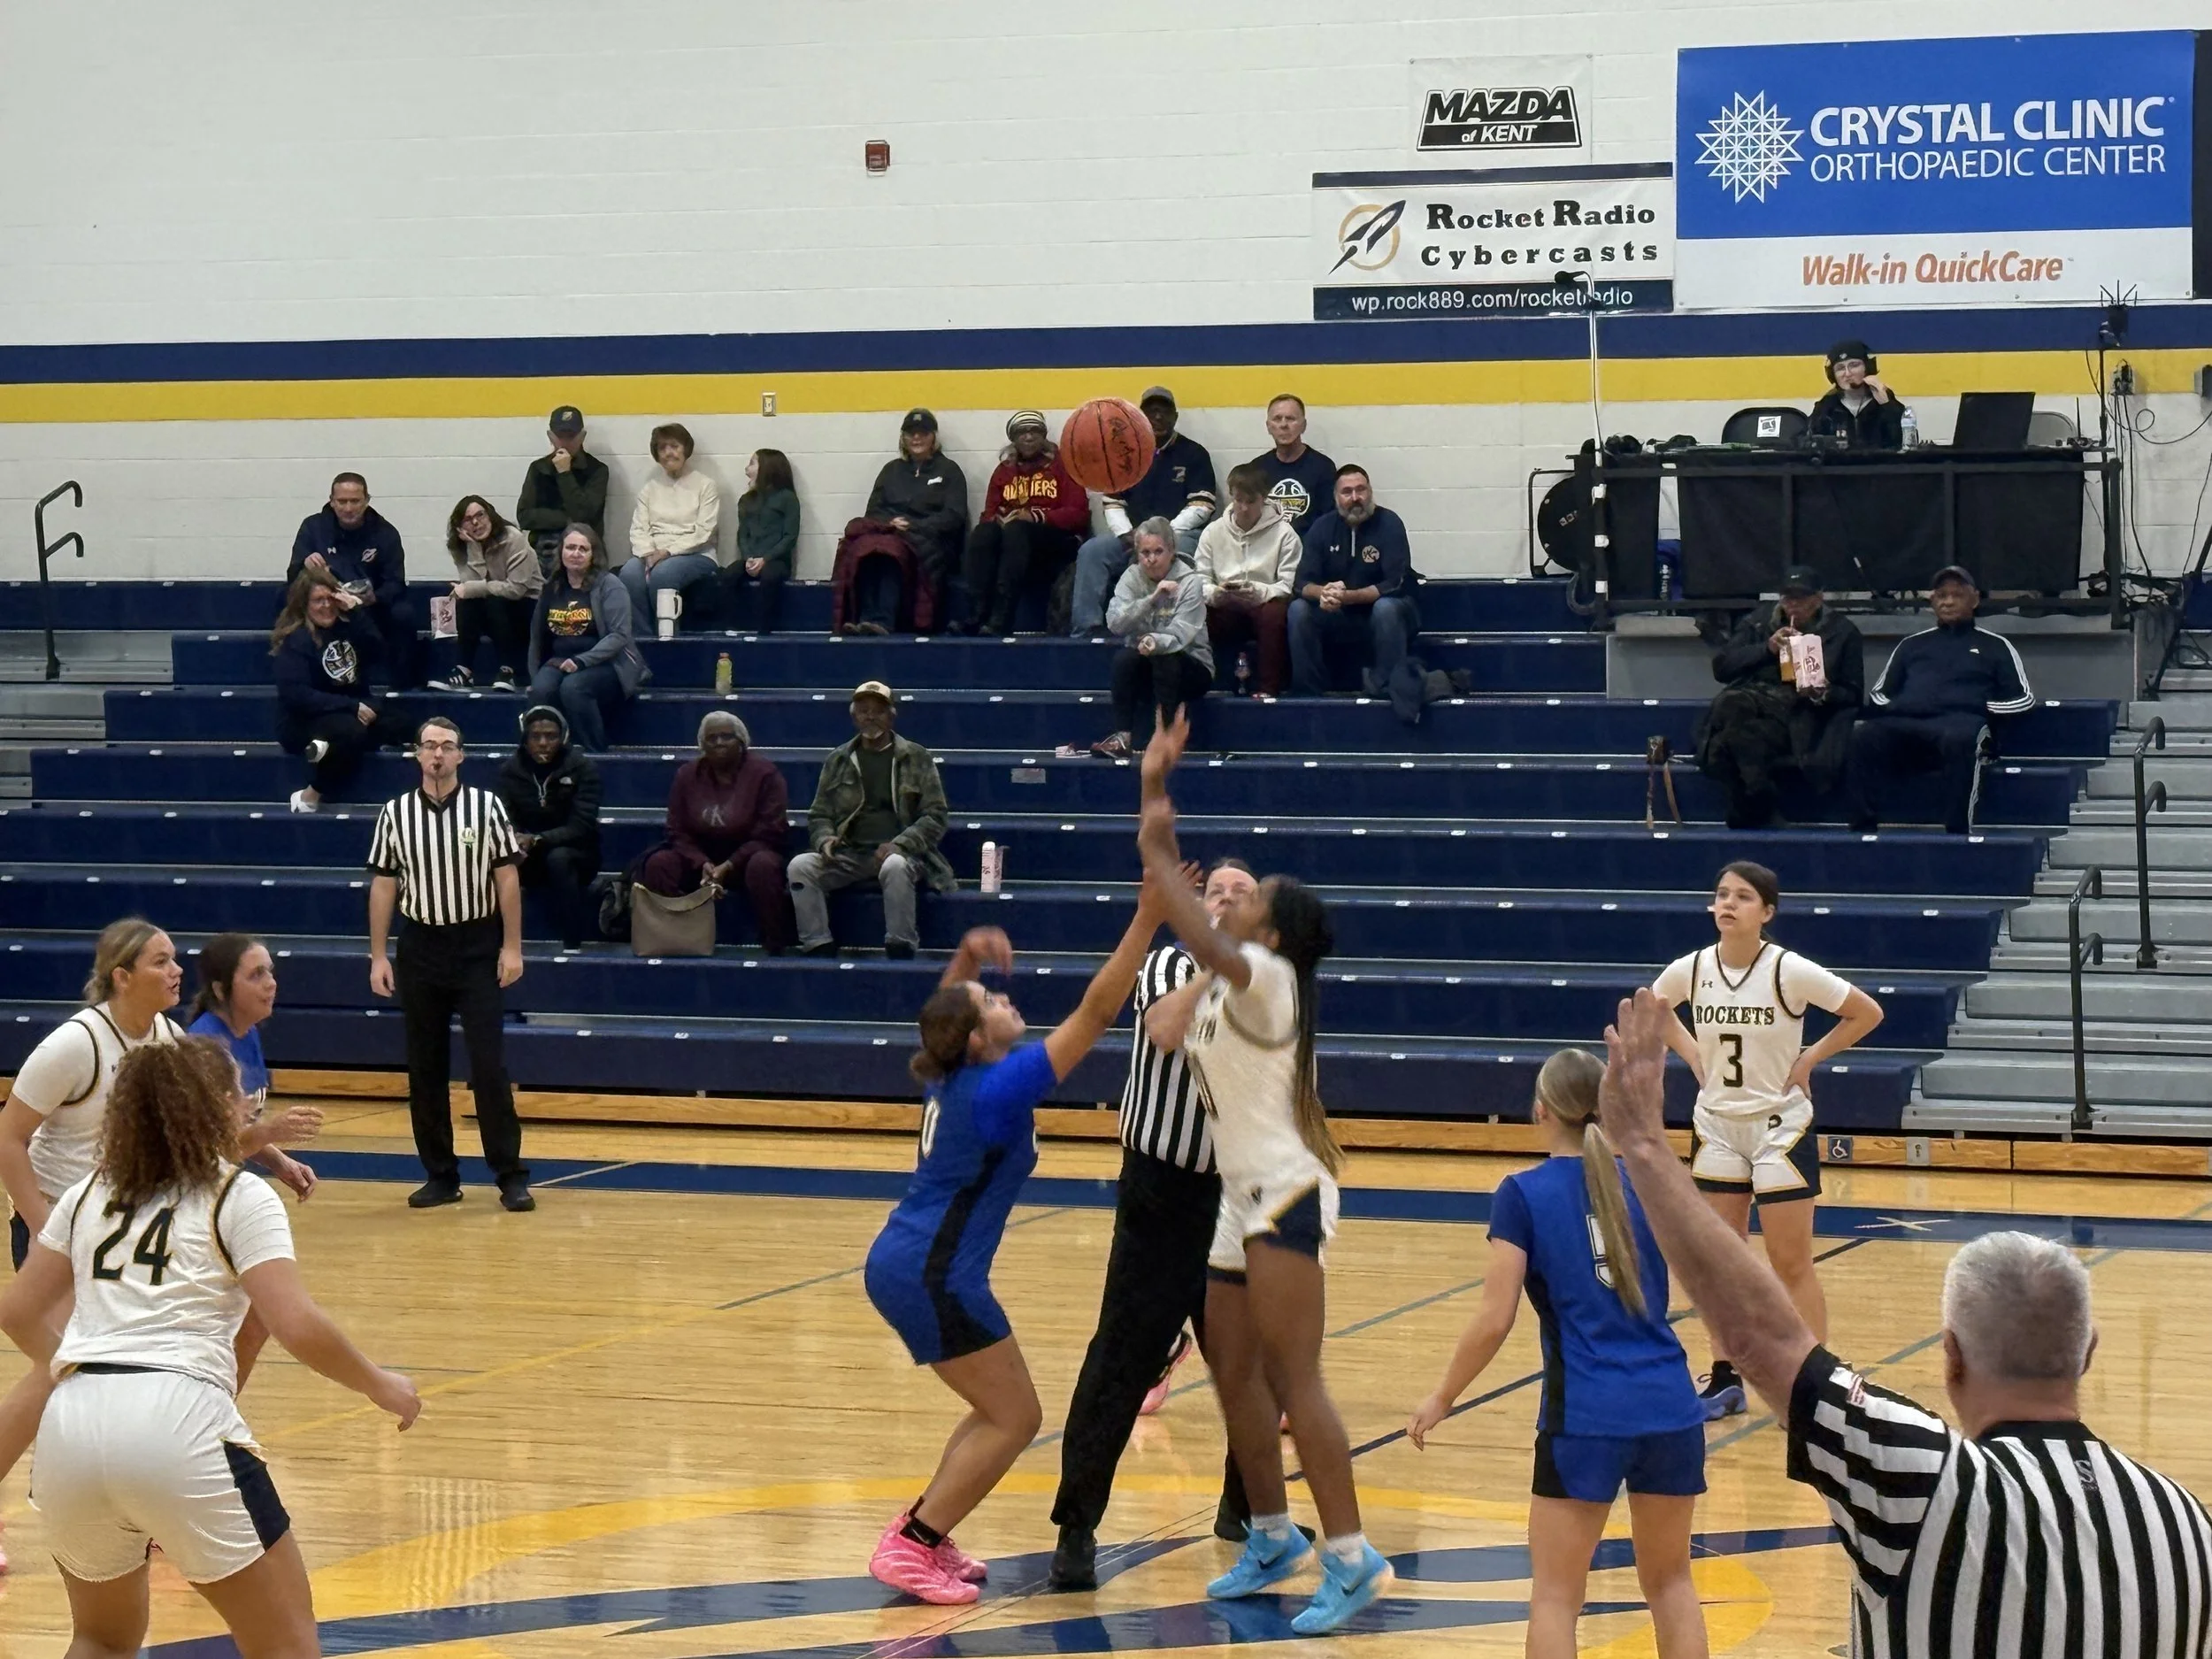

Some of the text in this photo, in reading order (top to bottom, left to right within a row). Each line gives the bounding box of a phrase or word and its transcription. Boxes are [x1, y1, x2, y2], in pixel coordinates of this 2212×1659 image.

[1425, 89, 1573, 123] MAZDA
[1810, 96, 2165, 147] CRYSTAL CLINIC
[1462, 125, 1537, 142] of KENT
[1810, 143, 2166, 182] ORTHOPAEDIC CENTER
[1426, 200, 1655, 230] Rocket Radio
[1421, 241, 1657, 270] Cybercasts
[1802, 250, 2063, 287] Walk-in QuickCare
[1695, 1004, 1775, 1025] ROCKETS
[1719, 1033, 1743, 1088] 3
[92, 1199, 173, 1286] 24
